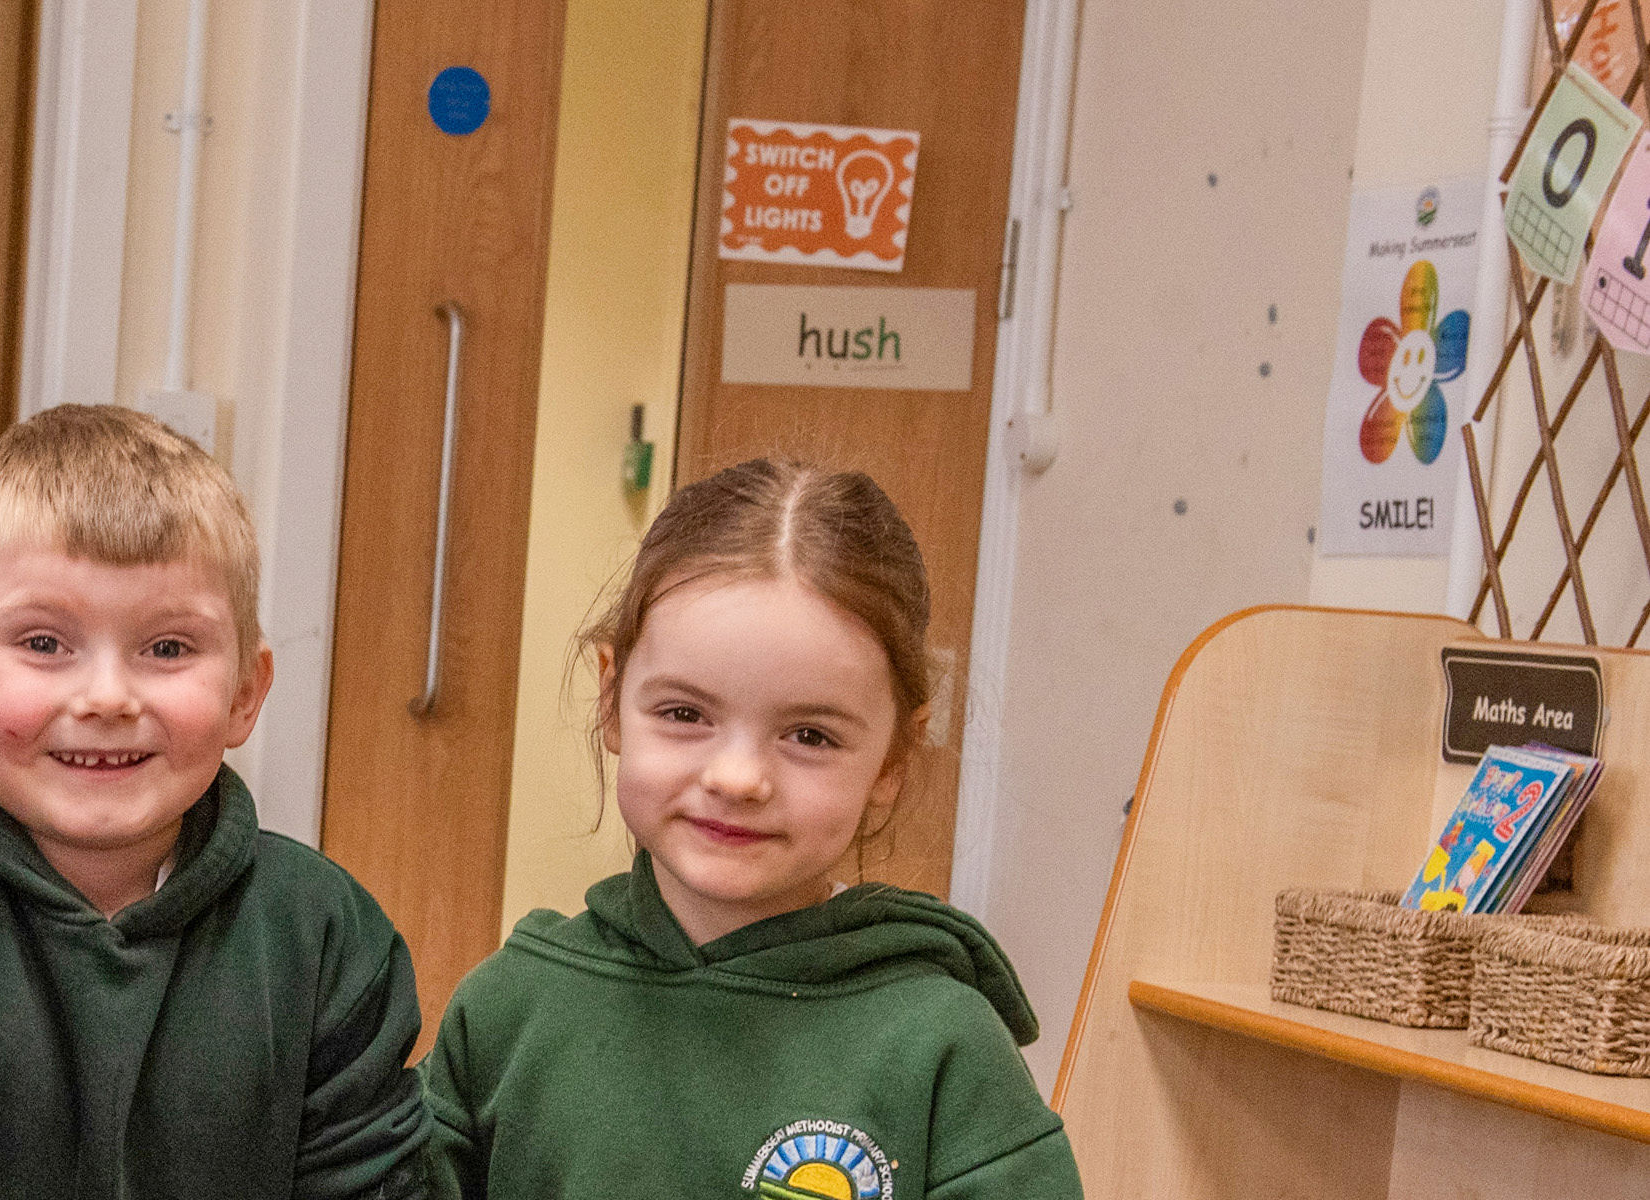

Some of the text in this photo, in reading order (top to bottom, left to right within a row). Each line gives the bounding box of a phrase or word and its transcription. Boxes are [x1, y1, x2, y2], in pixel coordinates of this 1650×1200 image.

[745, 143, 835, 171] SWITCH
[764, 173, 810, 198] OFF
[744, 205, 823, 232] LIGHTS
[798, 312, 901, 361] hush
[1359, 497, 1435, 530] SMILE!
[1472, 696, 1573, 730] Maths Area
[1494, 780, 1544, 842] 2
[785, 1119, 851, 1136] METHODIST
